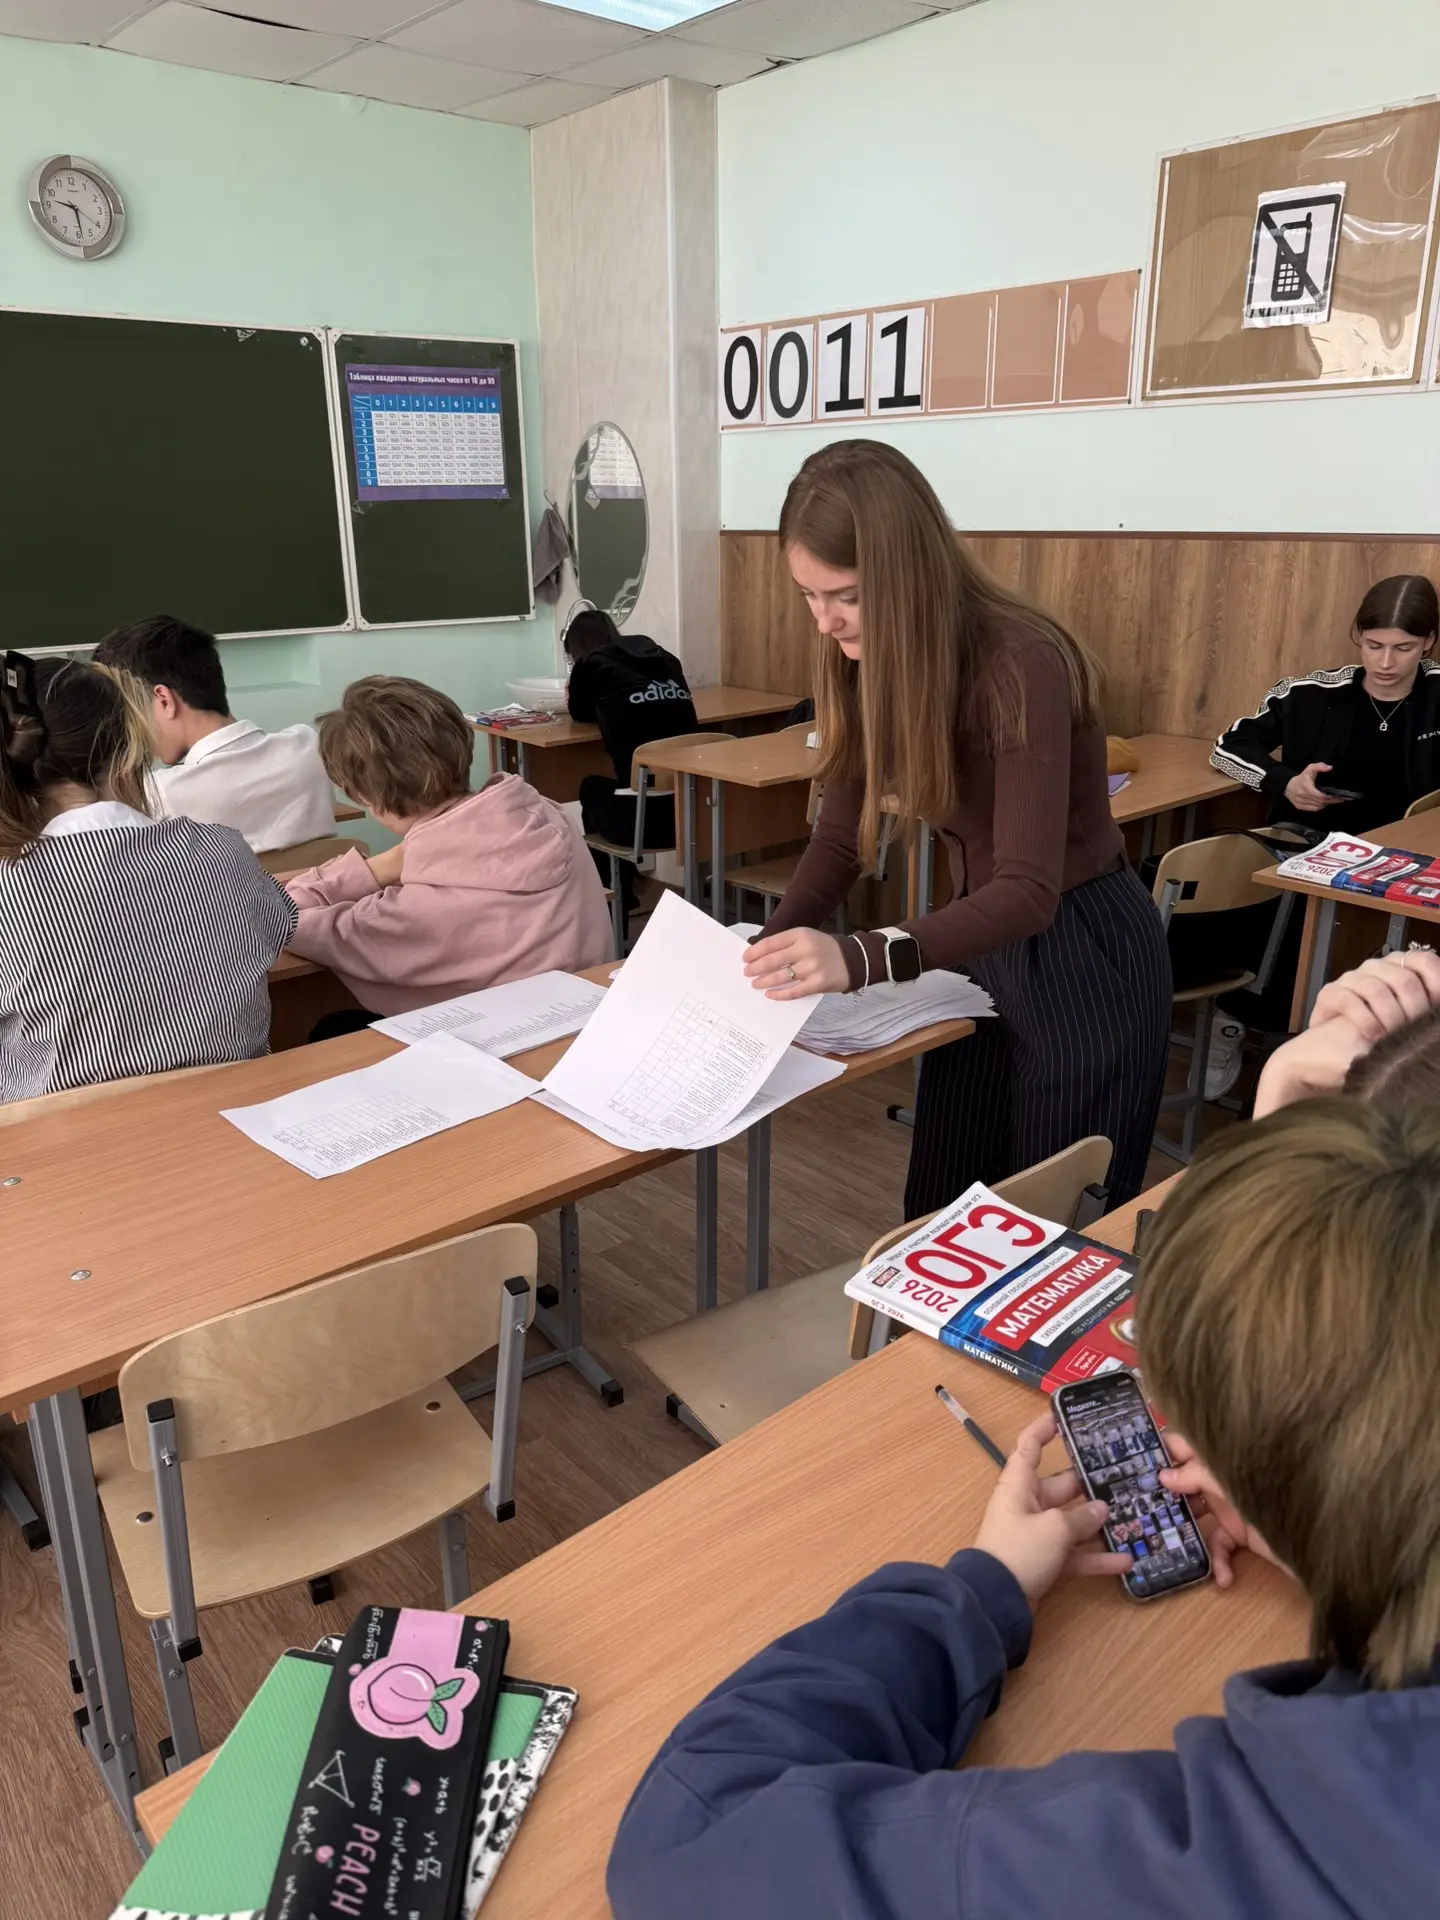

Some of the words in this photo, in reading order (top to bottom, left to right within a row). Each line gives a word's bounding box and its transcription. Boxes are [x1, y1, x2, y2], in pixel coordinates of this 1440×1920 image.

[55, 179, 63, 188] 11
[67, 177, 75, 186] 12
[47, 188, 56, 197] 10
[92, 193, 98, 203] 2
[46, 200, 52, 209] 9
[97, 206, 103, 215] 3
[52, 215, 58, 223] 8
[88, 228, 94, 237] 5
[349, 372, 374, 382] Таблица
[904, 1204, 1046, 1290] ОГЭ
[899, 1279, 959, 1313] 2026
[996, 1253, 1111, 1339] МАТЕМАТИКА
[963, 1343, 1019, 1376] МАТЕМАТИКА
[330, 1822, 381, 1917] PEACH
